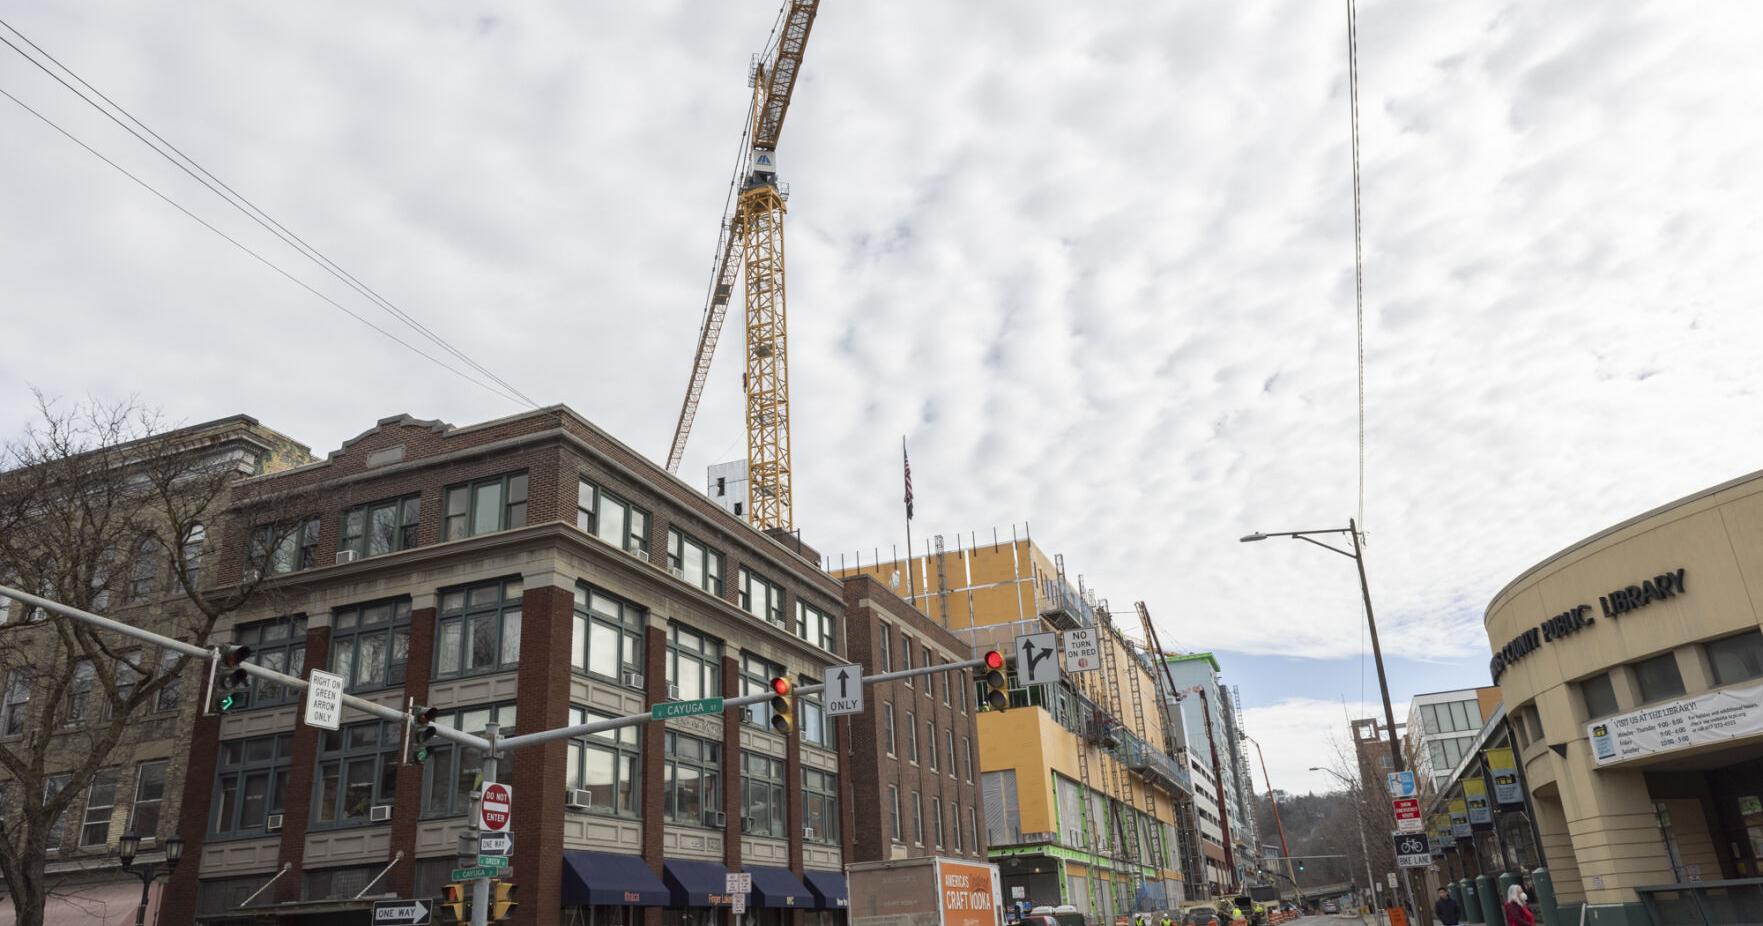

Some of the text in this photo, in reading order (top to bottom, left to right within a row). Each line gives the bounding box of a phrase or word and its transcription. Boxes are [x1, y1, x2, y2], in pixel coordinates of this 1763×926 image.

[1502, 568, 1686, 665] COUNTY PUBLIC LIBRARY
[1072, 631, 1087, 640] NO
[1072, 640, 1091, 649] TURN
[1068, 648, 1096, 658] ON RED
[313, 675, 330, 687] RIGHT
[315, 688, 336, 700] GREEN
[313, 700, 335, 711] ARROW
[667, 703, 705, 716] CAYUGA
[830, 700, 858, 711] ONLY
[314, 711, 331, 722] ONLY
[1614, 702, 1697, 728] VISIT US AT THE LIBRARY!
[486, 791, 508, 802] DO NOT
[486, 812, 506, 823] ENTER
[482, 839, 505, 849] ONE WAY
[485, 857, 501, 866] GREEN
[1415, 854, 1431, 865] LANE
[462, 868, 486, 879] CAYUGA
[945, 873, 970, 888] AMERICA'S
[946, 891, 992, 912] CRAFT VODKA
[378, 907, 416, 918] ONE WAY
